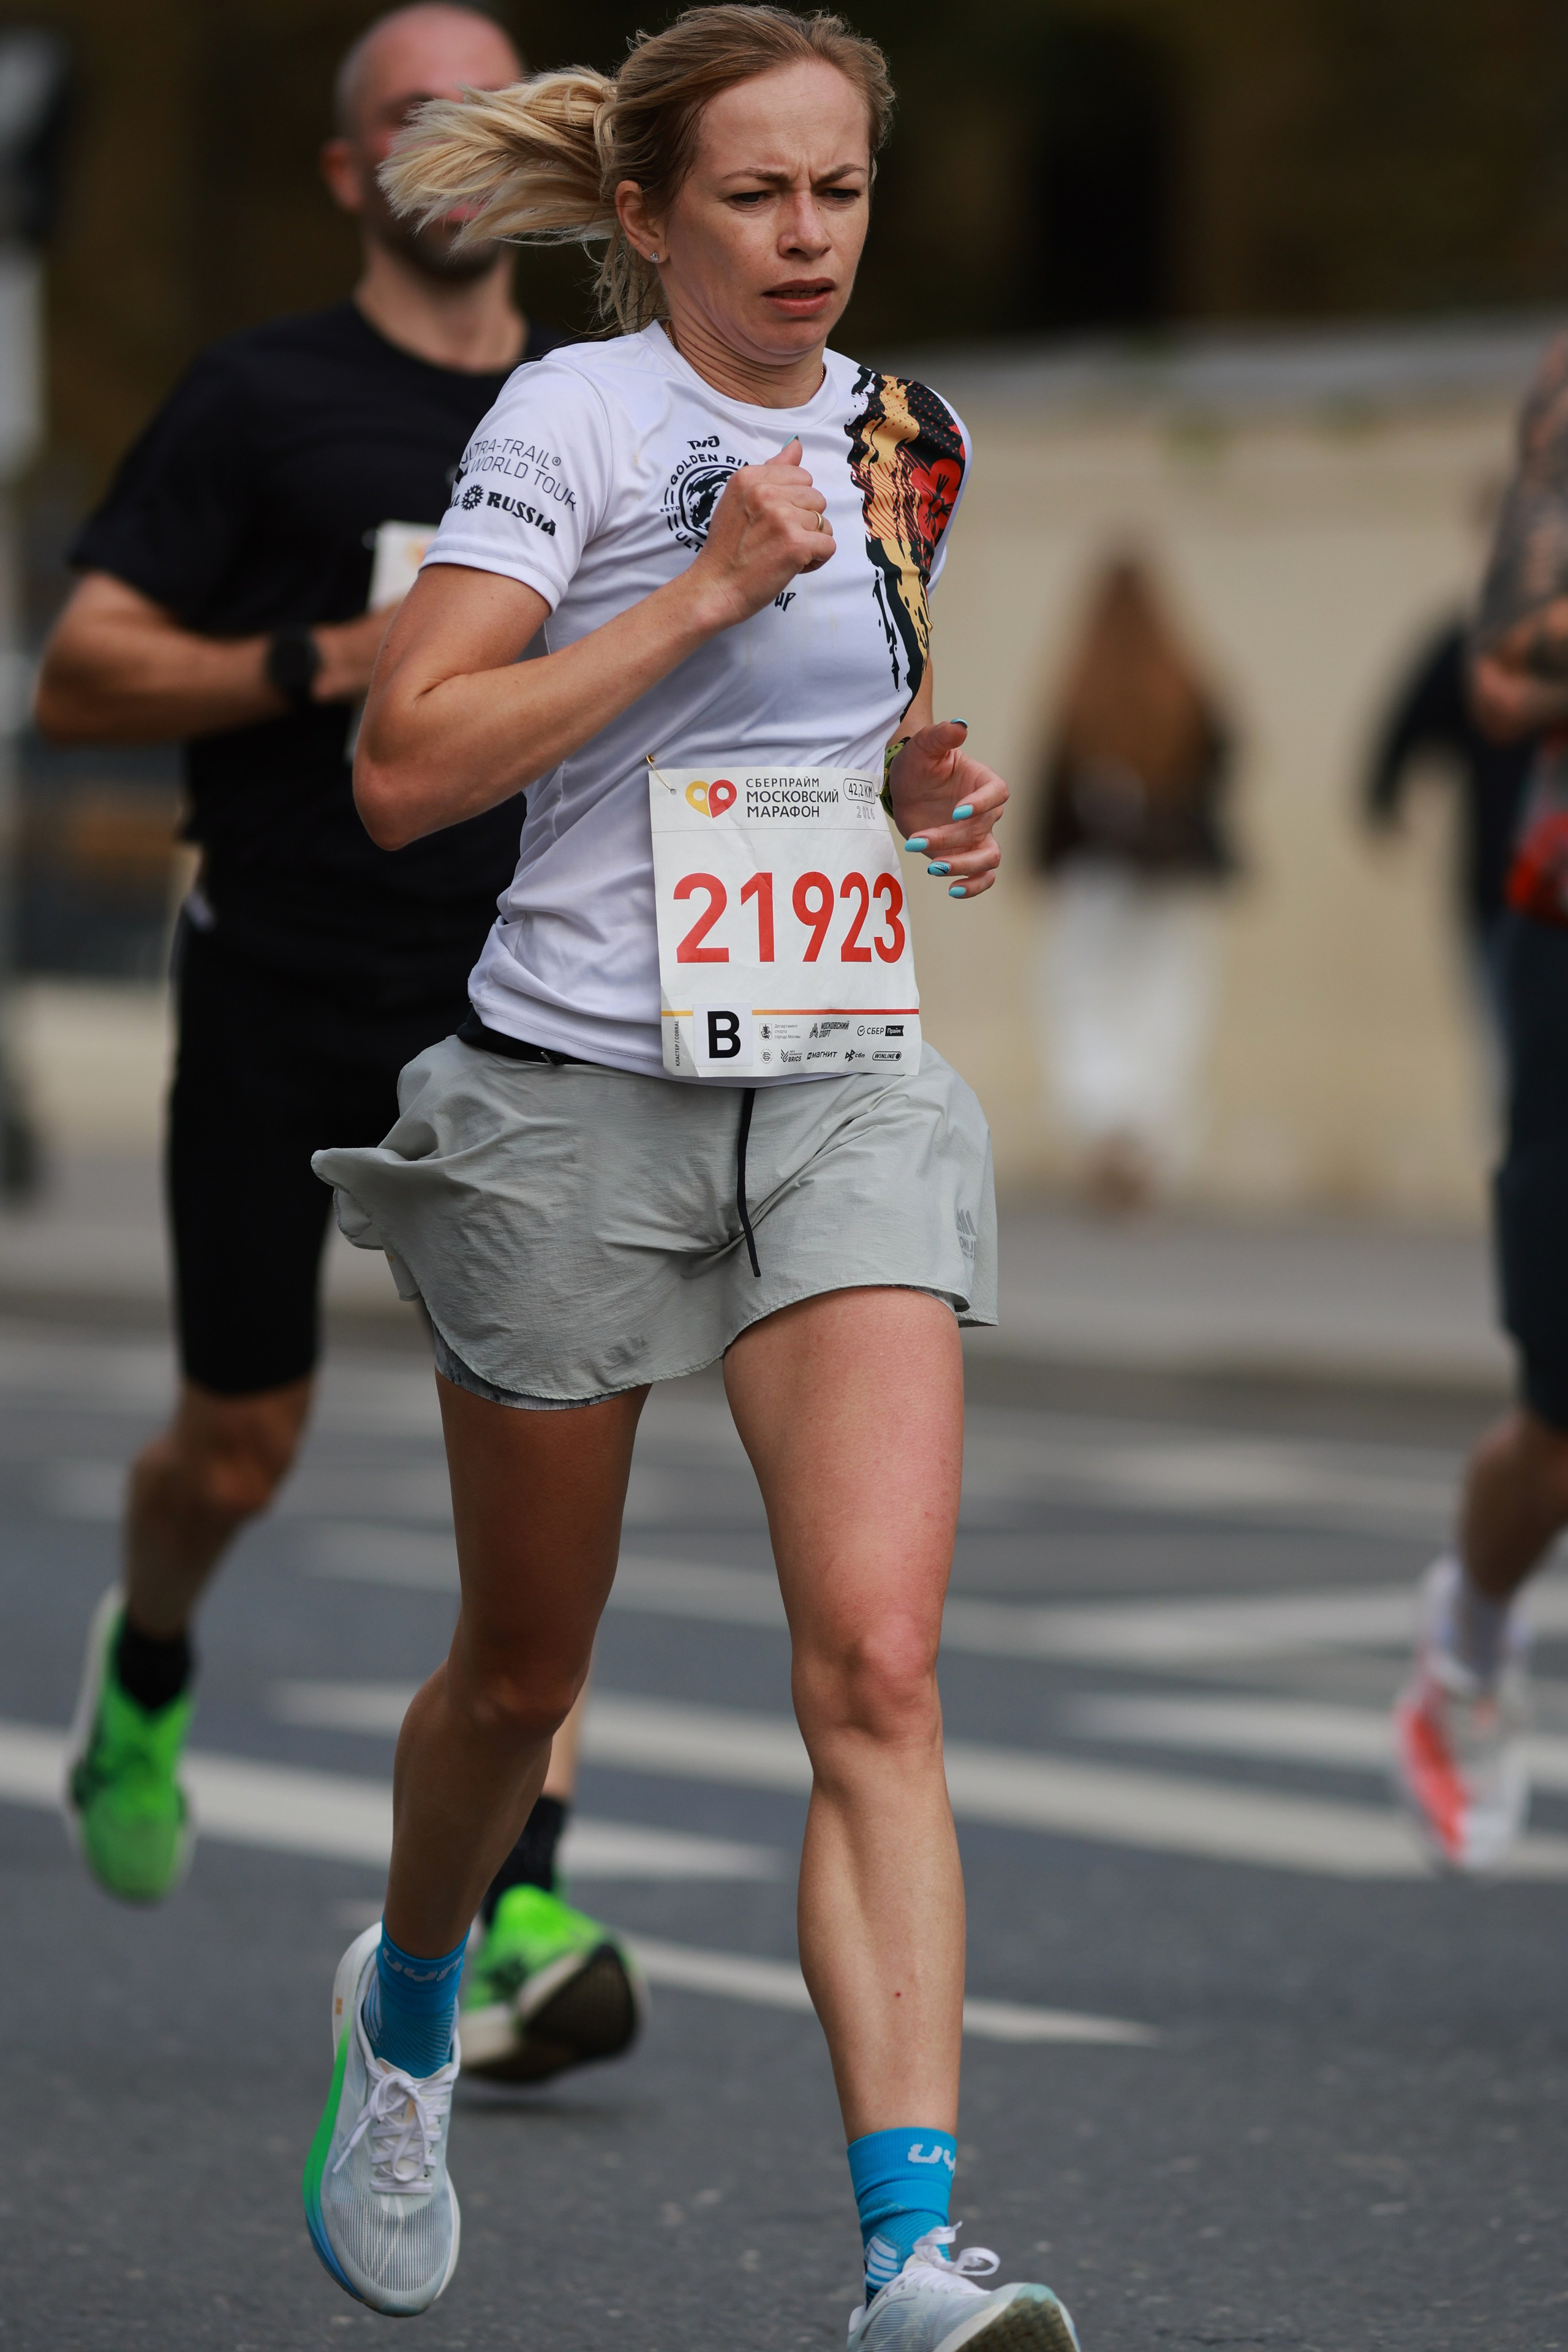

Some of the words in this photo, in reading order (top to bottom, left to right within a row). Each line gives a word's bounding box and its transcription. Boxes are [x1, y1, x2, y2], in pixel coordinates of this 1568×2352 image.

[671, 453, 718, 485] GOLDEN
[470, 456, 529, 479] WORLD
[533, 469, 577, 511] TOUR
[486, 491, 556, 537] RUSSIA
[675, 531, 704, 552] ULT
[745, 776, 820, 788] СБЕРПРАЙМ
[848, 783, 864, 797] 42,2
[746, 789, 839, 803] МОСКОВСКИЙ
[747, 805, 820, 818] МАРАФОН
[673, 871, 906, 963] 21923
